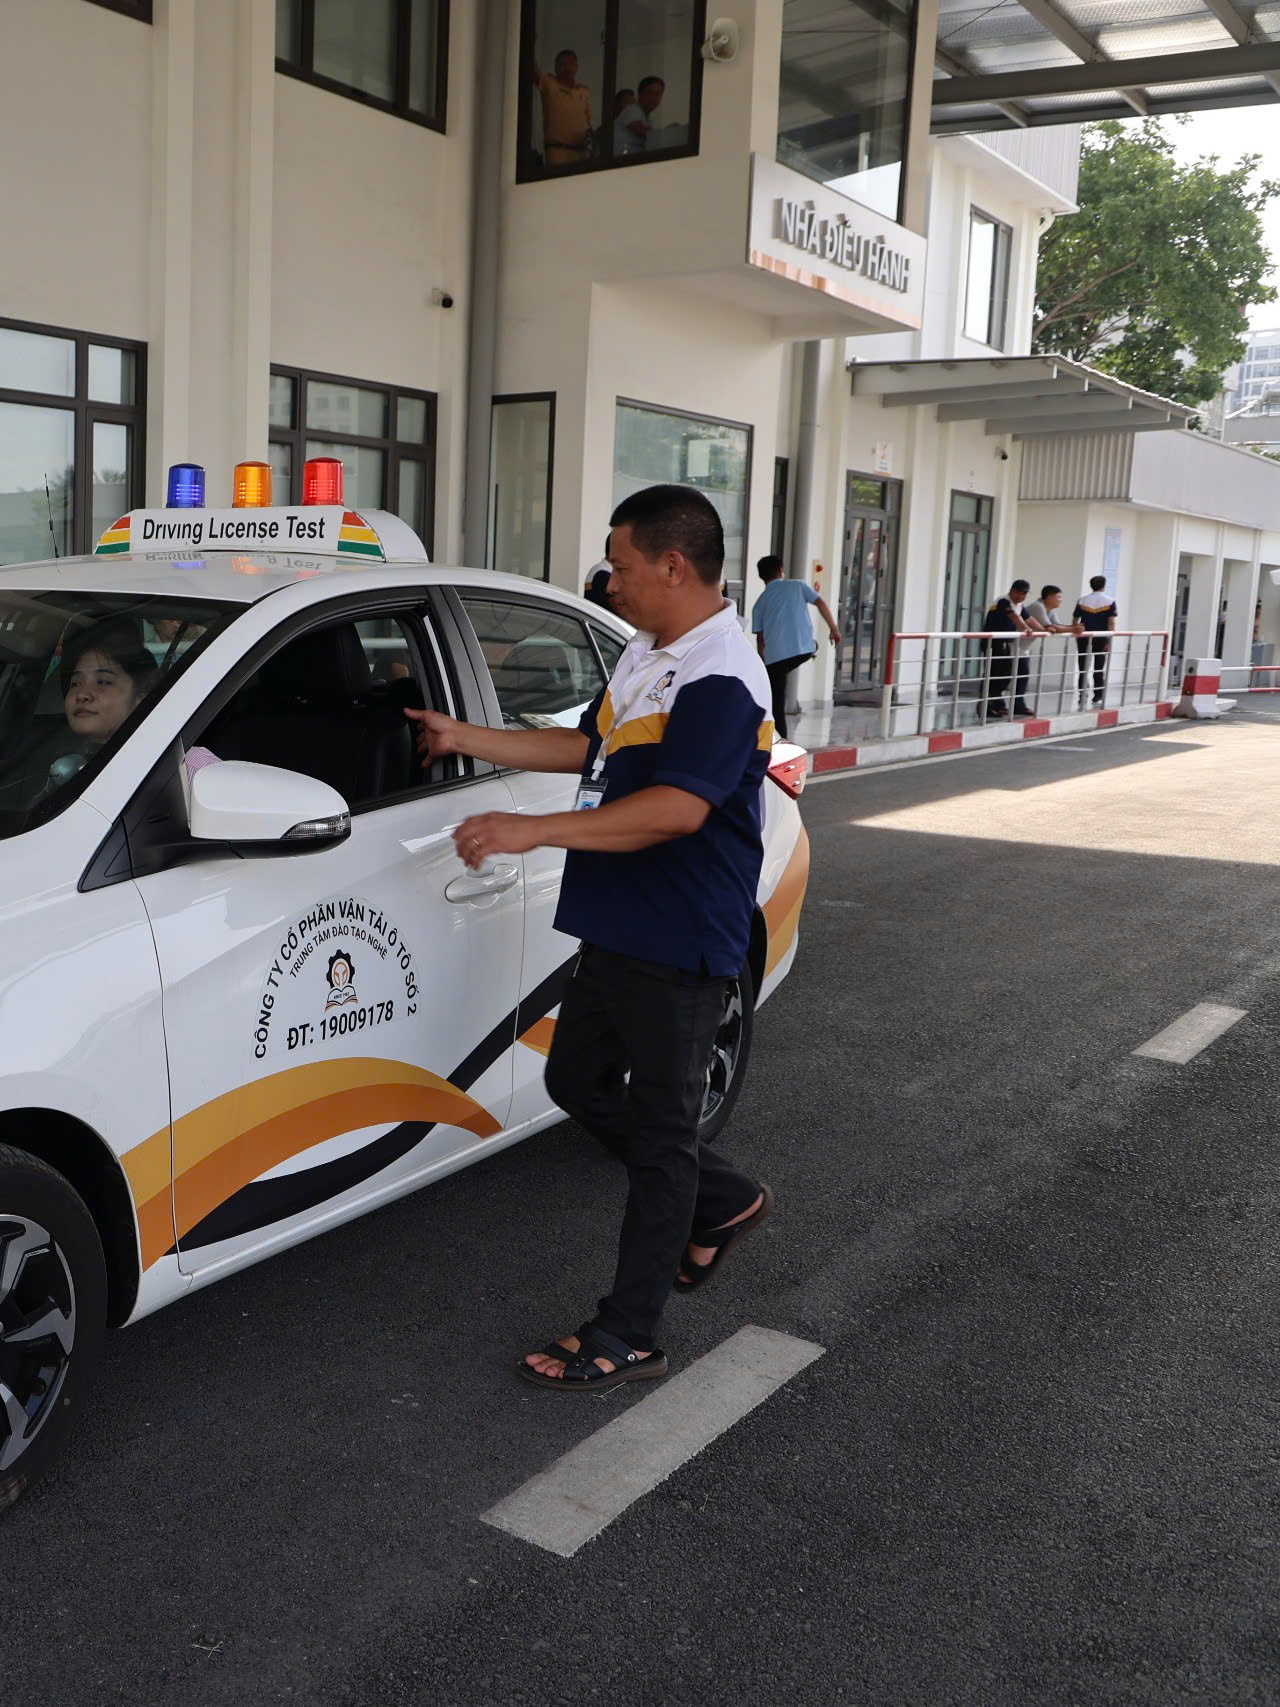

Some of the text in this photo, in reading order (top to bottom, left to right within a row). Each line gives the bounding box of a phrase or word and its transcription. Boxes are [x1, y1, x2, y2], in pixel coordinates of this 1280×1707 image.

[781, 198, 821, 255] NHÀ
[867, 235, 911, 293] HÀNH
[142, 515, 326, 545] Driving License Test
[254, 897, 420, 1058] CÔNG TY CỔ PHẦN VẬN TẢI Ô TÔ SỐ 2
[289, 942, 314, 979] TRUNG
[312, 929, 331, 947] TÂM
[332, 923, 349, 937] ĐÀO
[351, 926, 366, 941] TẠO
[287, 1000, 394, 1050] ĐT: 19009178
